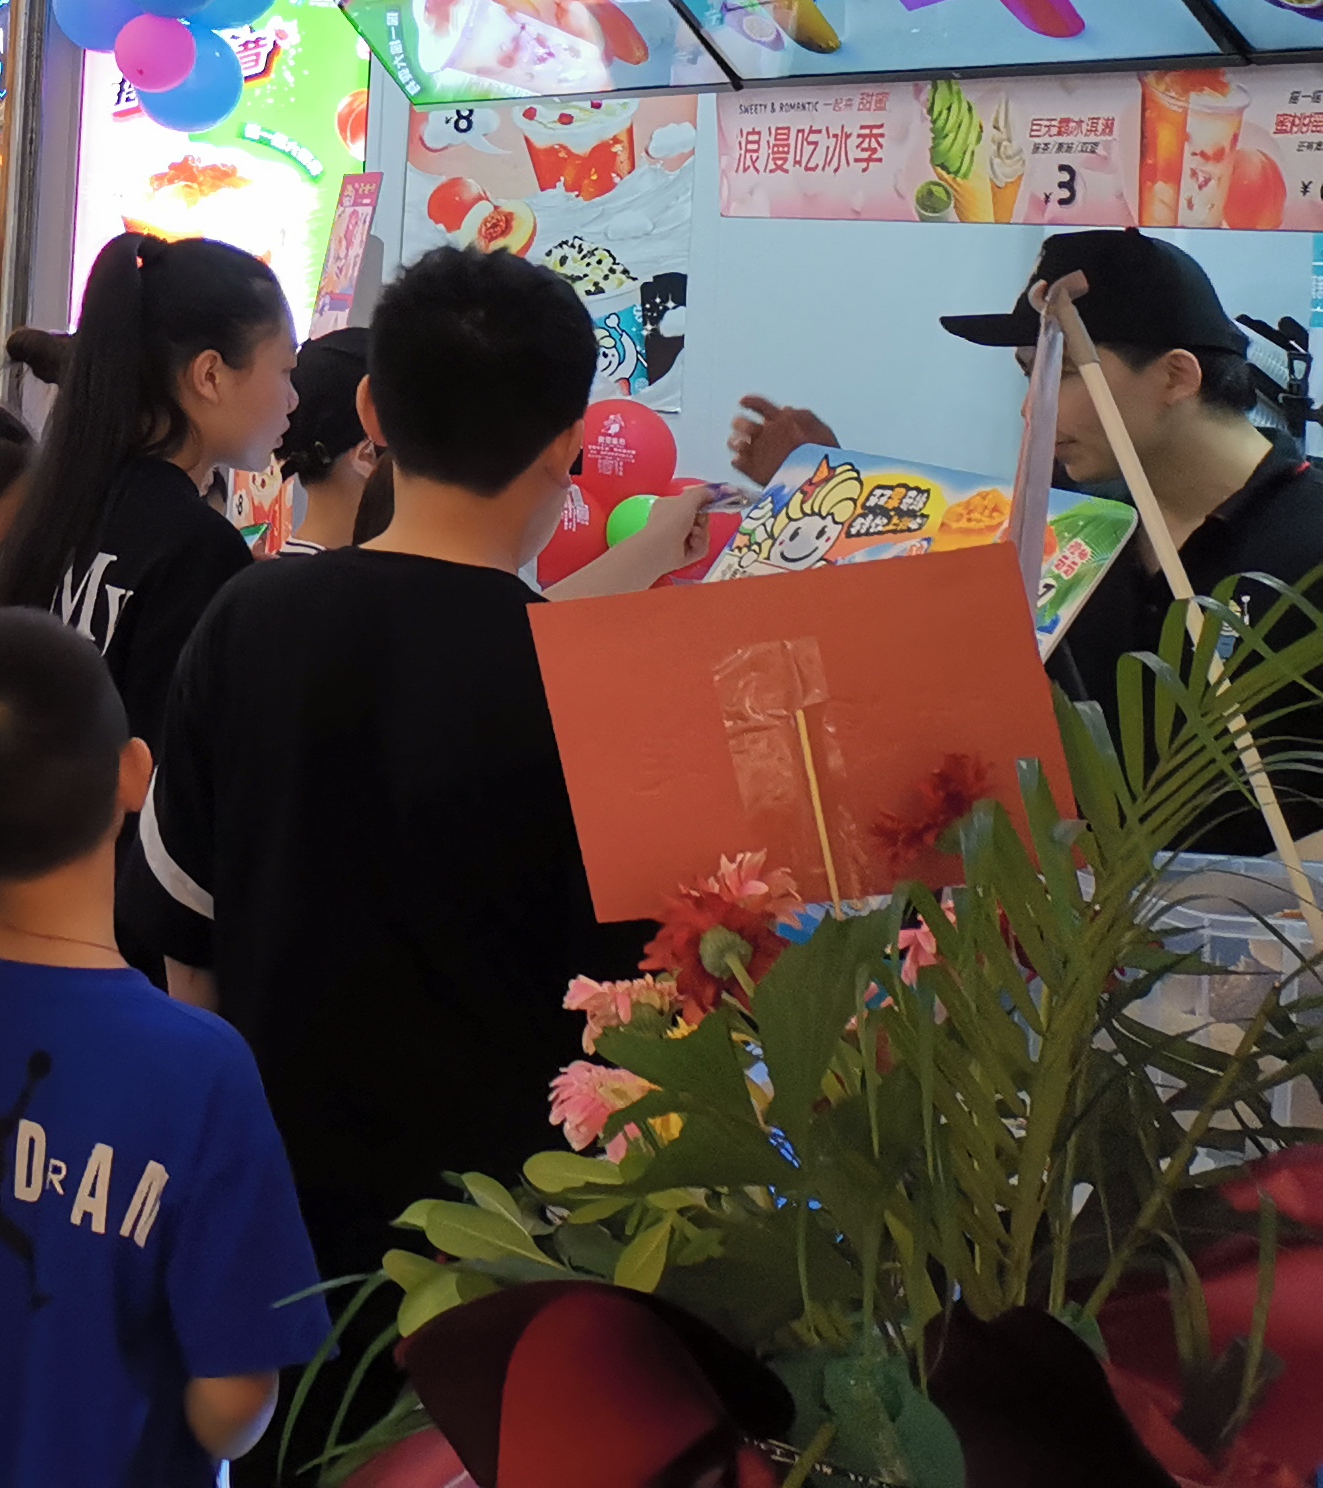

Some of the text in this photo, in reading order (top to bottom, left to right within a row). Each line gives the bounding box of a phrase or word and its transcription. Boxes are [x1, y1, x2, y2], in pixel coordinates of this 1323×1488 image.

[734, 122, 886, 174] 浪漫吃冰季
